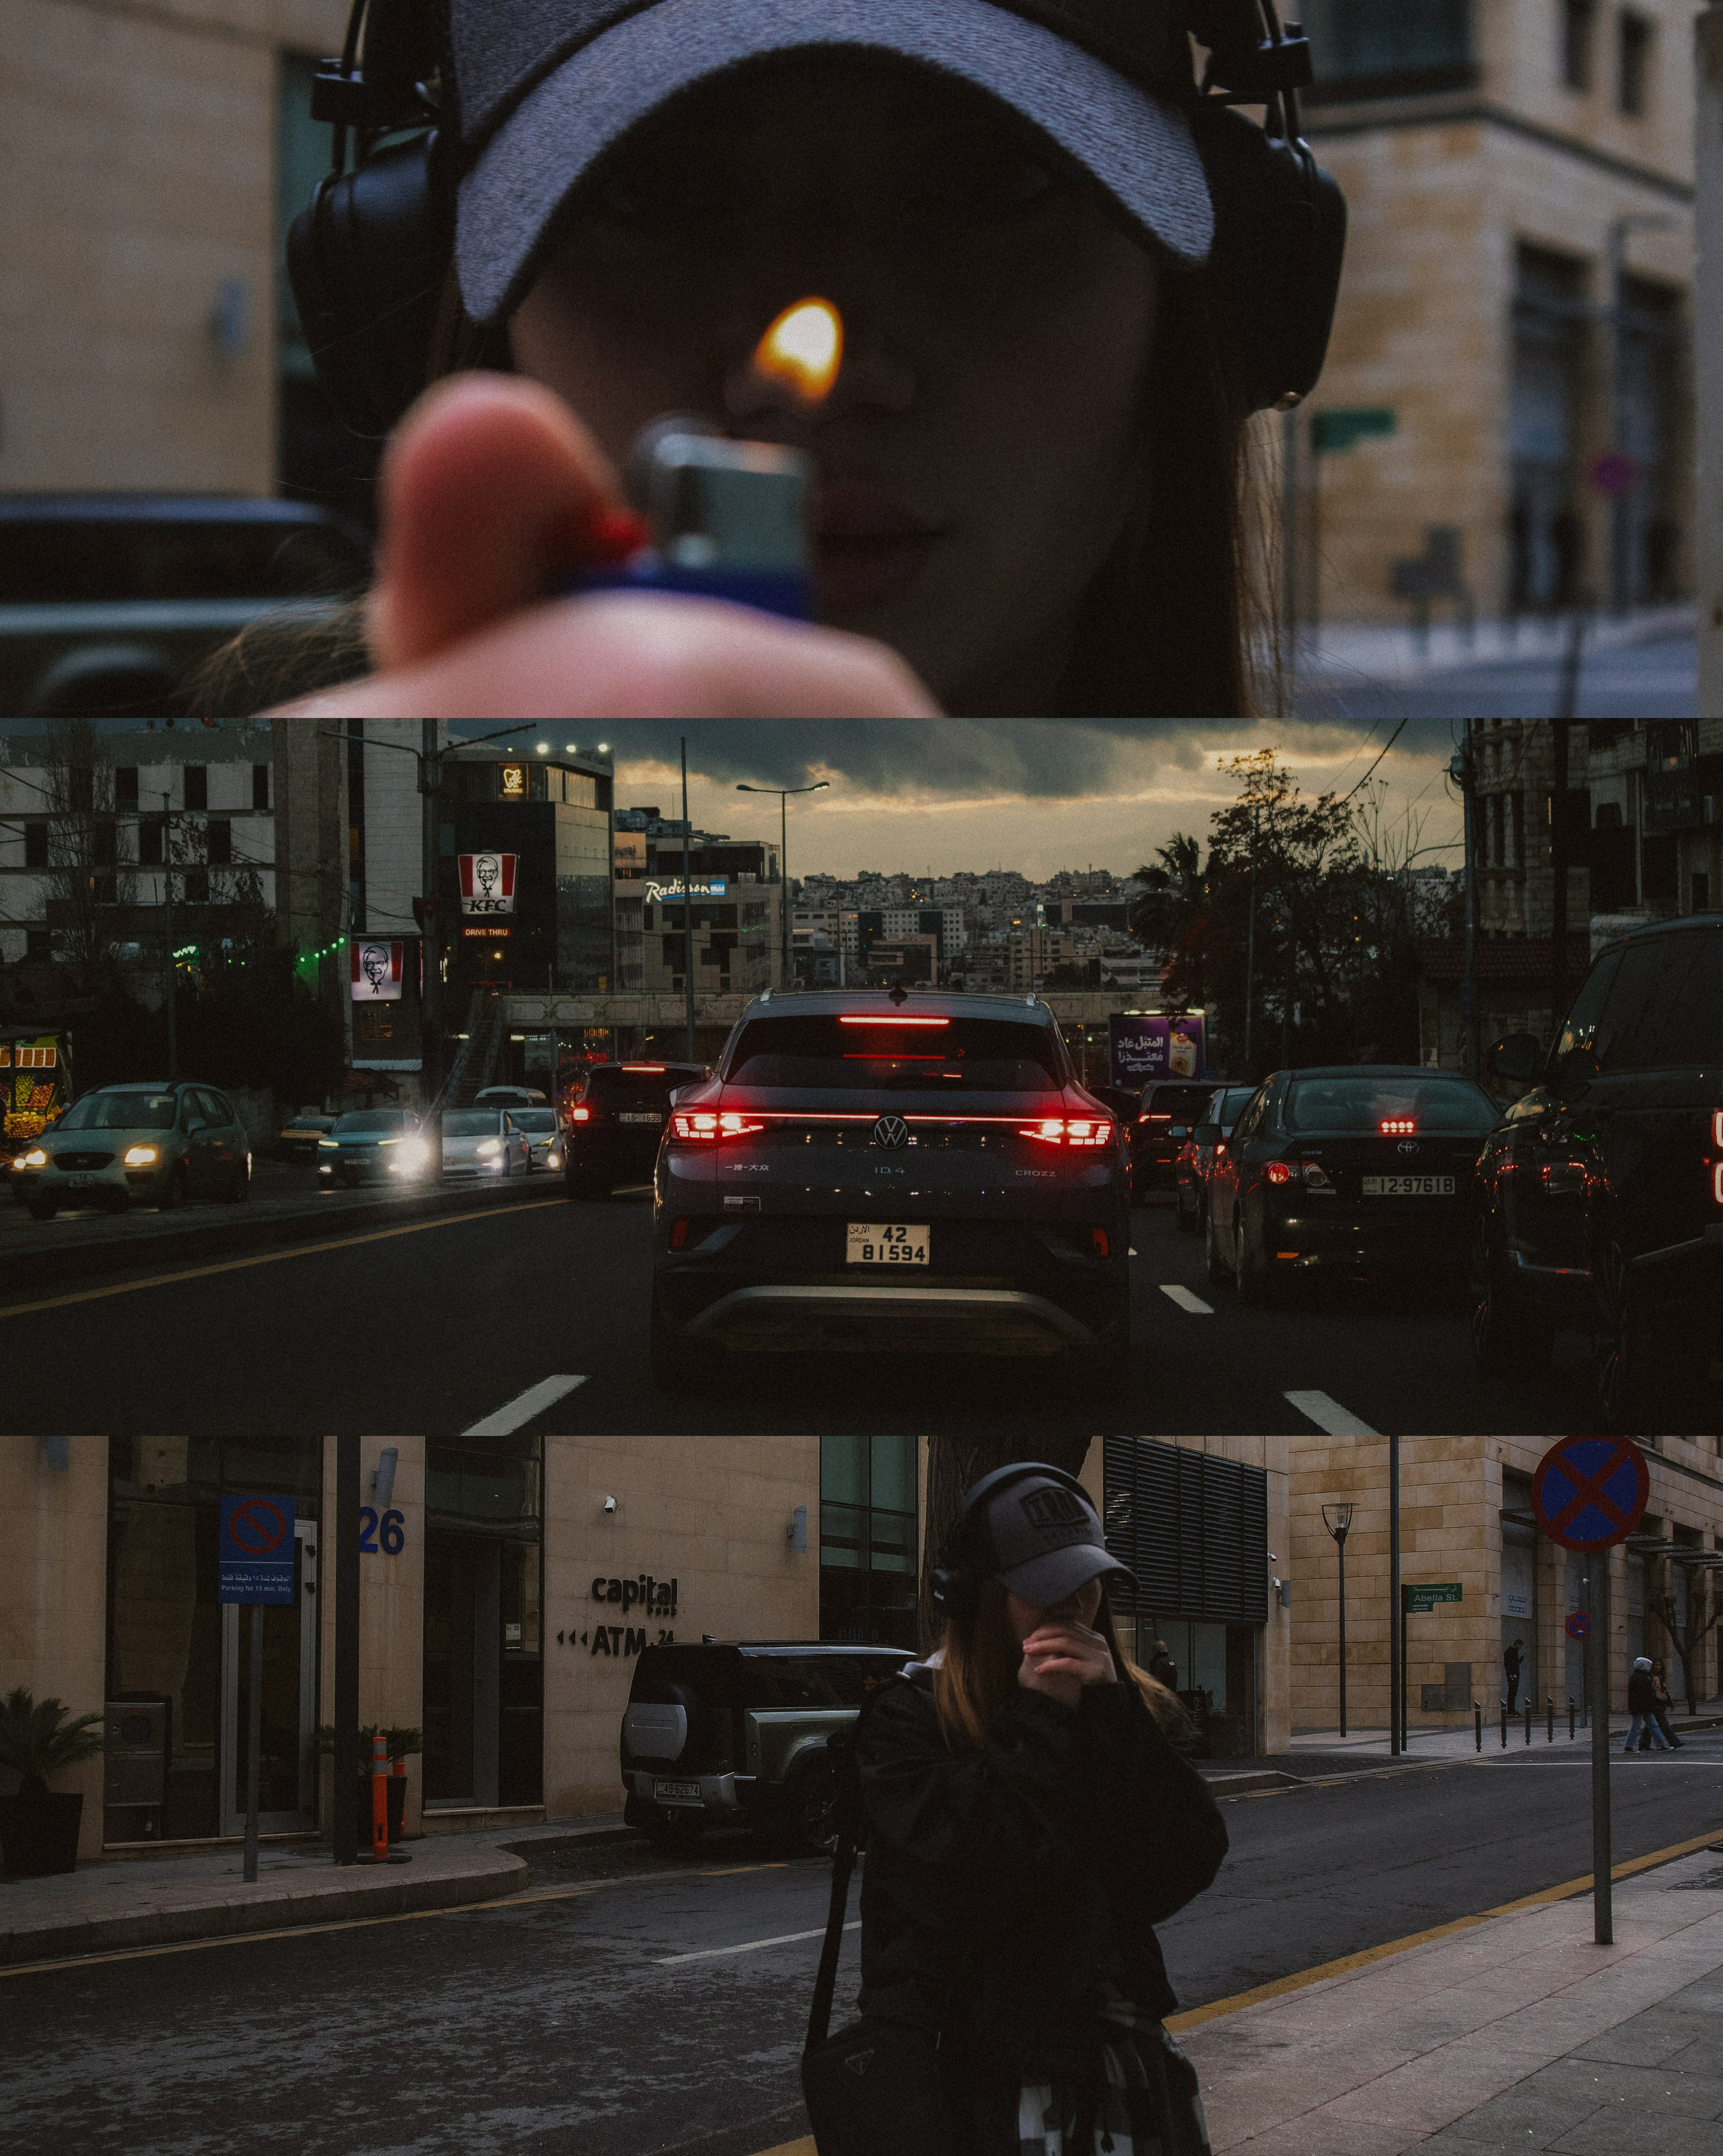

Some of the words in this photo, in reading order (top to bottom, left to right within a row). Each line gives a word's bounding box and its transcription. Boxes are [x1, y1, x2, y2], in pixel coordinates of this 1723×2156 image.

[645, 878, 710, 903] Radisson
[469, 899, 506, 912] KFC
[643, 1114, 660, 1122] 1699
[1380, 1178, 1454, 1193] 12-97618
[883, 1226, 907, 1243] 42
[863, 1245, 925, 1261] 81594
[359, 1506, 405, 1555] 26
[235, 1574, 252, 1583] دقيقة
[271, 1574, 291, 1583] الوقوف
[592, 1574, 678, 1612] capital
[1414, 1594, 1443, 1602] Abella
[1446, 1593, 1458, 1601] St.
[591, 1625, 647, 1657] ATM
[658, 1629, 674, 1642] 24
[664, 1784, 699, 1795] 49-62674
